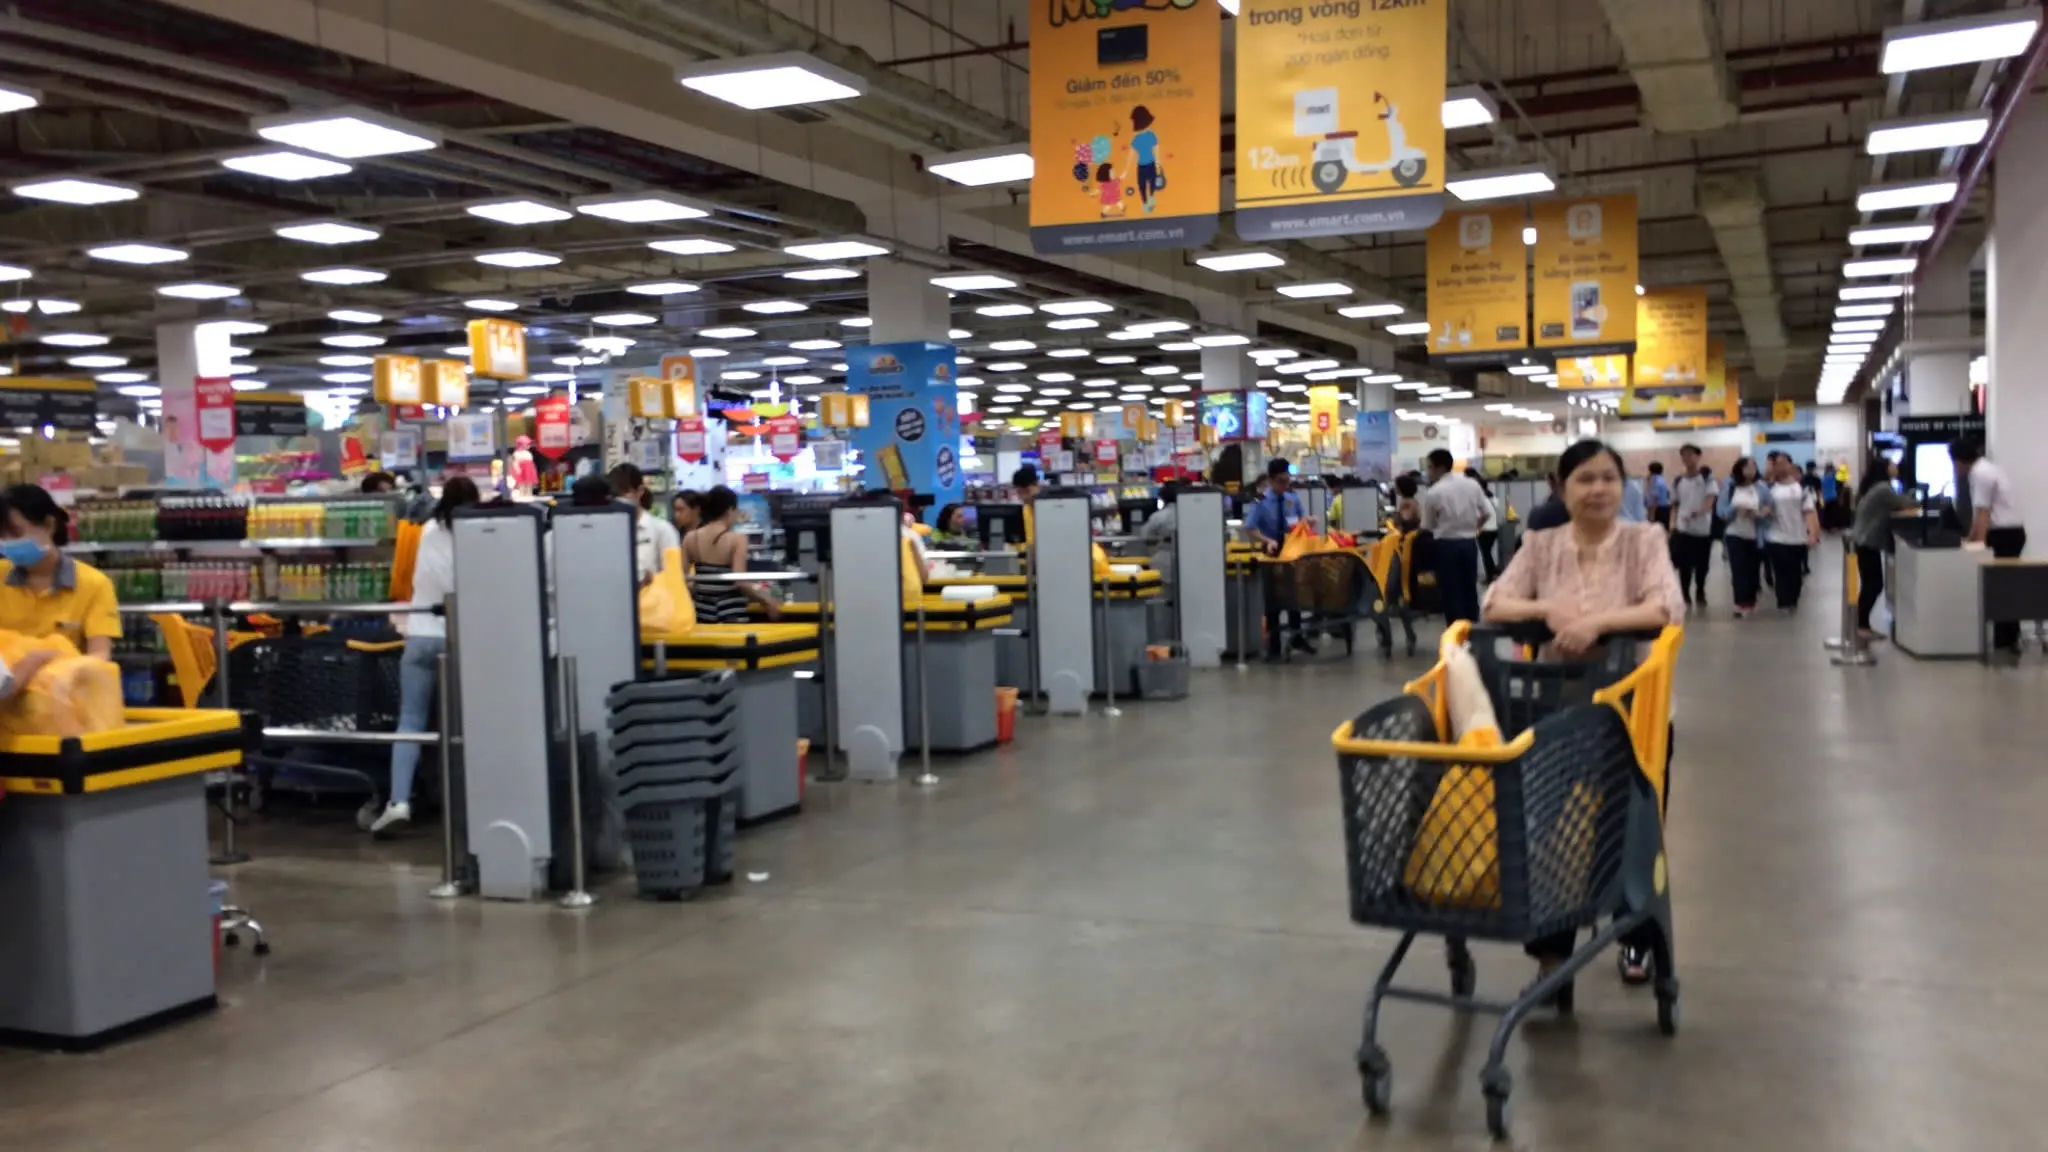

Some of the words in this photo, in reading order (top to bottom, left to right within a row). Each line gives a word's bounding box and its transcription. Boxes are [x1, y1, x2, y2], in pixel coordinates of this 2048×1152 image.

[1249, 7, 1303, 26] trong
[1310, 0, 1361, 18] vòng
[1146, 69, 1182, 85] 50%
[1270, 209, 1405, 230] www.emart.com.vn
[1062, 228, 1184, 246] www.emart.com.vn
